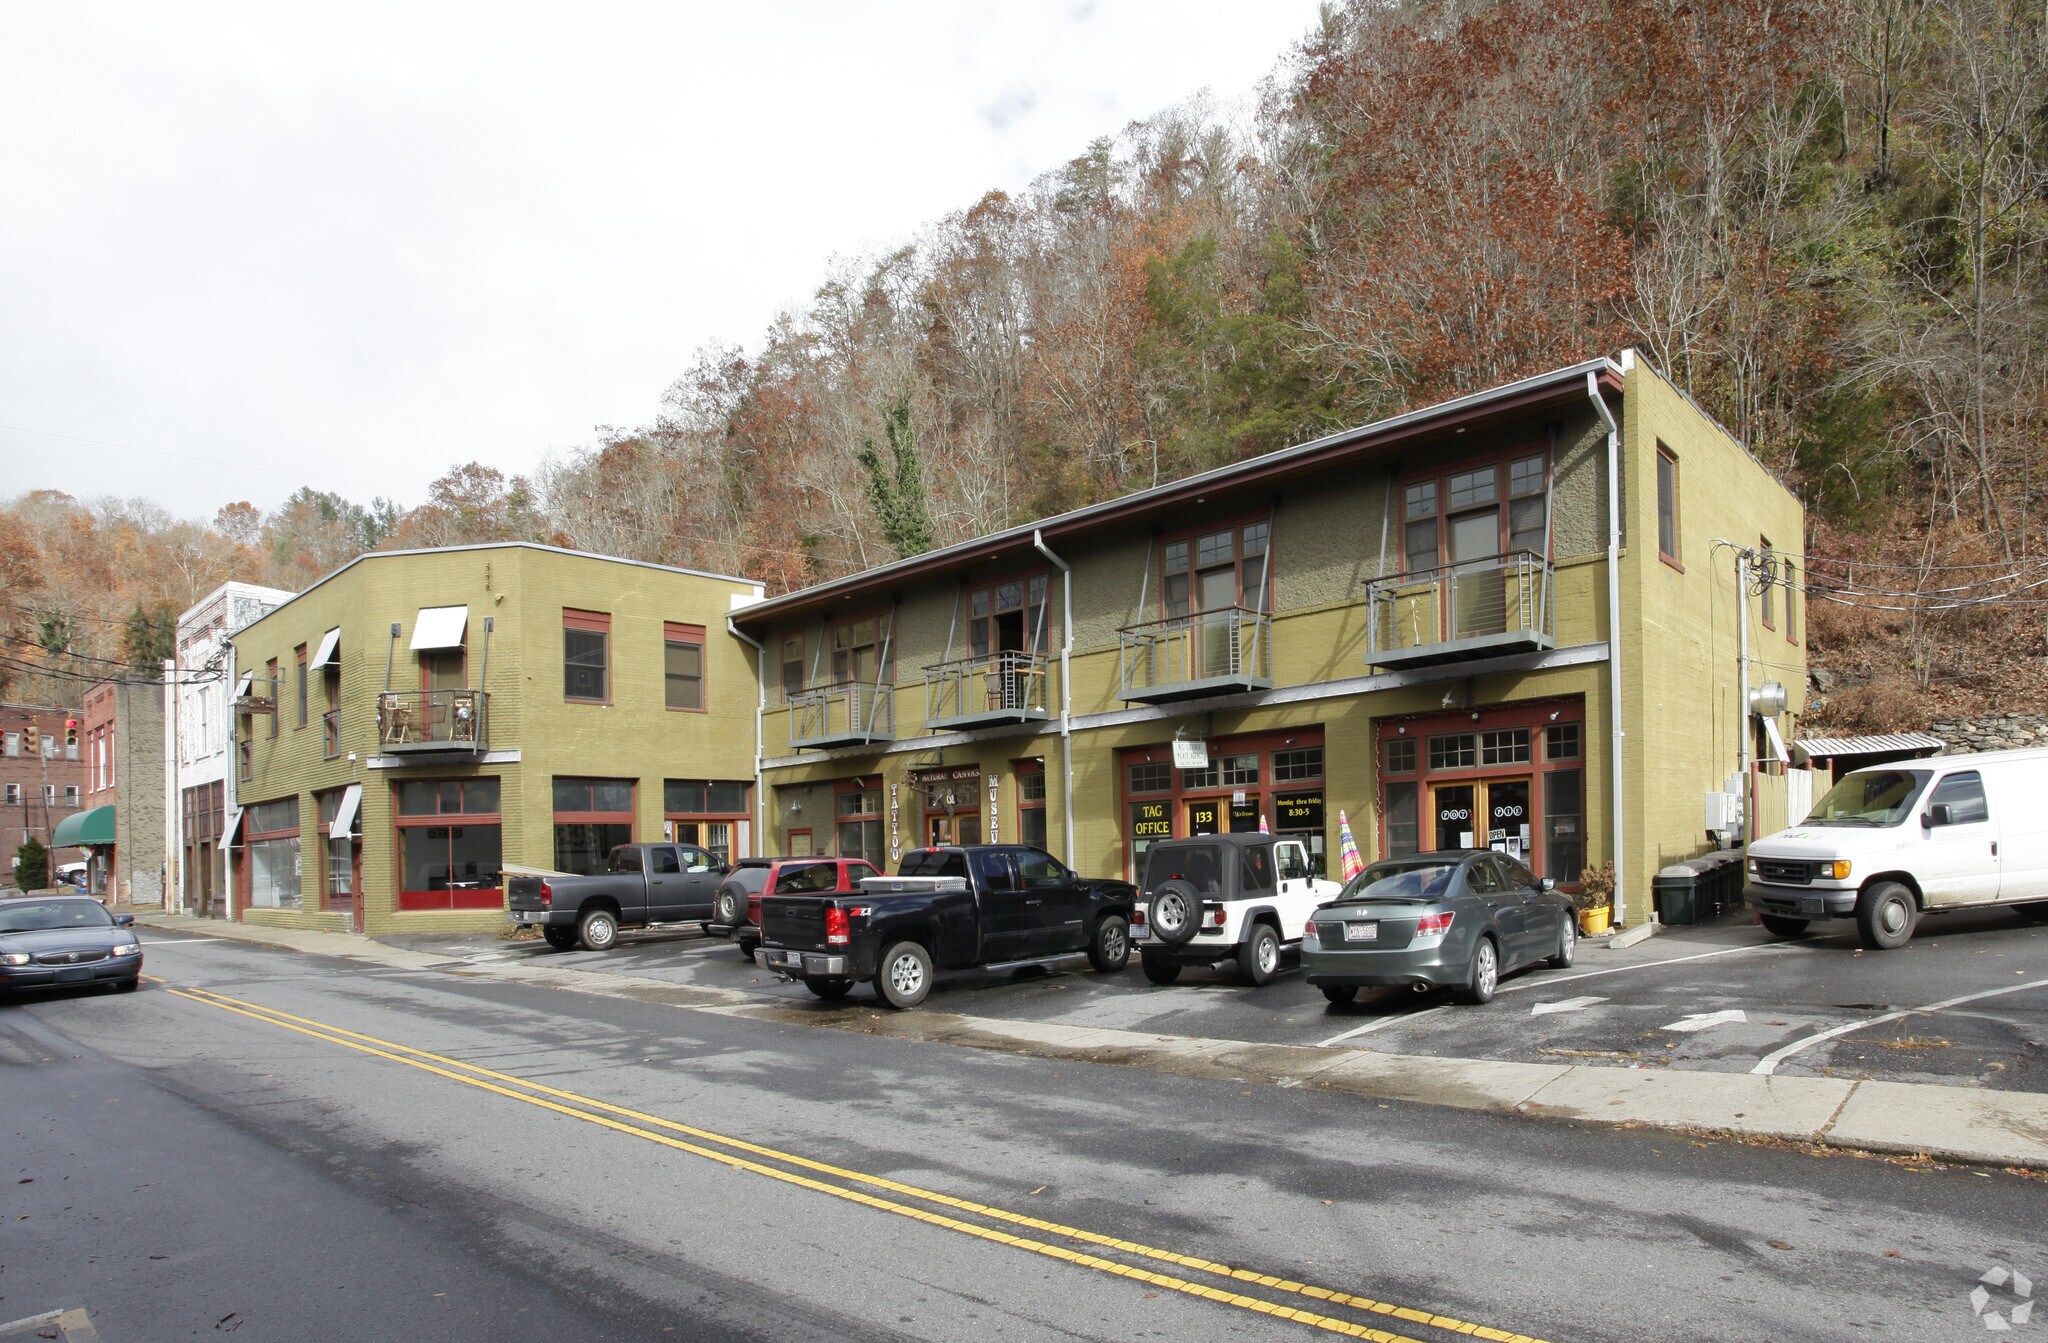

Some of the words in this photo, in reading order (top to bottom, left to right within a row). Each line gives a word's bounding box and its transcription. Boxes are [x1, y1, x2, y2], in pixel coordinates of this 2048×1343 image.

[952, 769, 980, 780] CANVAS
[988, 774, 999, 844] MUSEU
[1142, 805, 1163, 818] TAG
[1288, 807, 1310, 817] 8:30-5
[1441, 809, 1468, 820] POT
[1494, 806, 1522, 817] PIE
[890, 783, 899, 861] TATTOO
[1196, 811, 1213, 823] 133
[1135, 821, 1170, 835] OFFICE
[1488, 829, 1505, 840] OPEN
